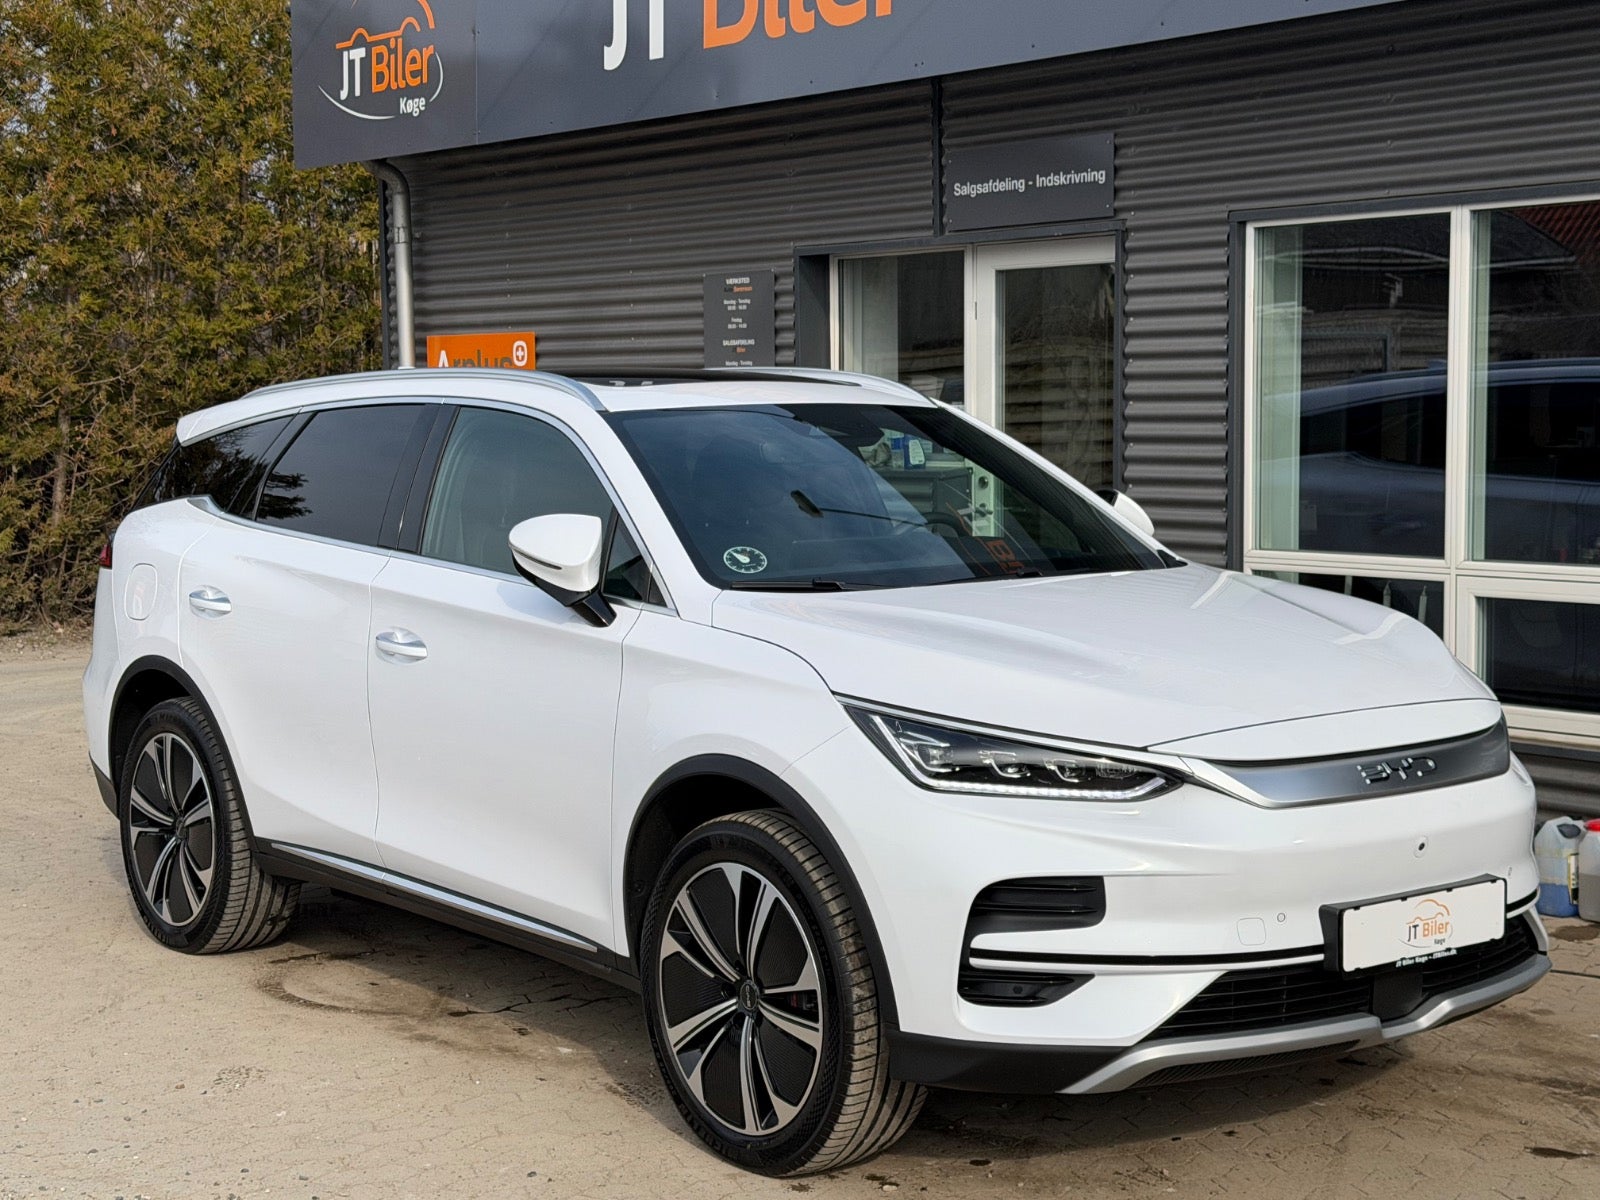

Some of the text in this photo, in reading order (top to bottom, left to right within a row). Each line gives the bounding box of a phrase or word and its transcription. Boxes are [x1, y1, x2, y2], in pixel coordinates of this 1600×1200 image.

[340, 37, 434, 101] JT Biler
[399, 97, 426, 117] Køge
[953, 177, 1026, 198] Salgsafdeling
[1036, 168, 1106, 188] Indskrivning
[1356, 757, 1436, 785] BYD
[1407, 920, 1450, 942] JT Biler
